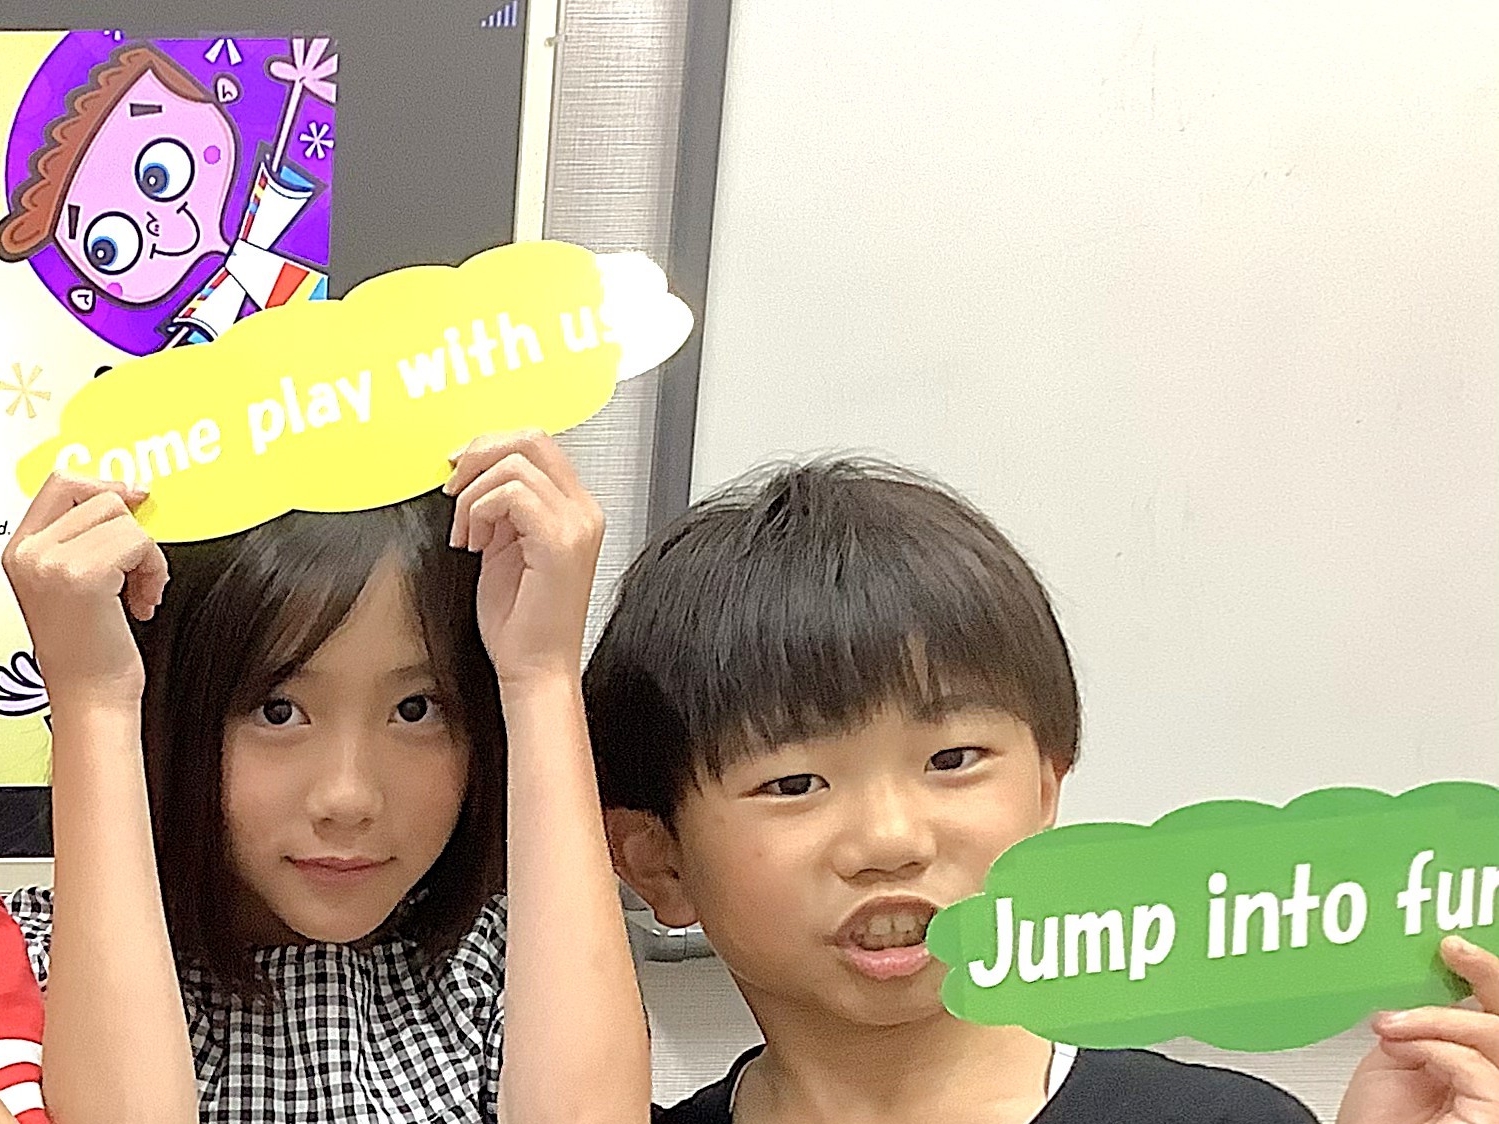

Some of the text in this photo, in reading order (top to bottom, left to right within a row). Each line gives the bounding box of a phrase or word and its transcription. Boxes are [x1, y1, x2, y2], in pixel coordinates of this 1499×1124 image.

[247, 368, 374, 455] play
[397, 310, 545, 399] with
[967, 896, 1177, 989] Jump
[1206, 863, 1368, 960] into
